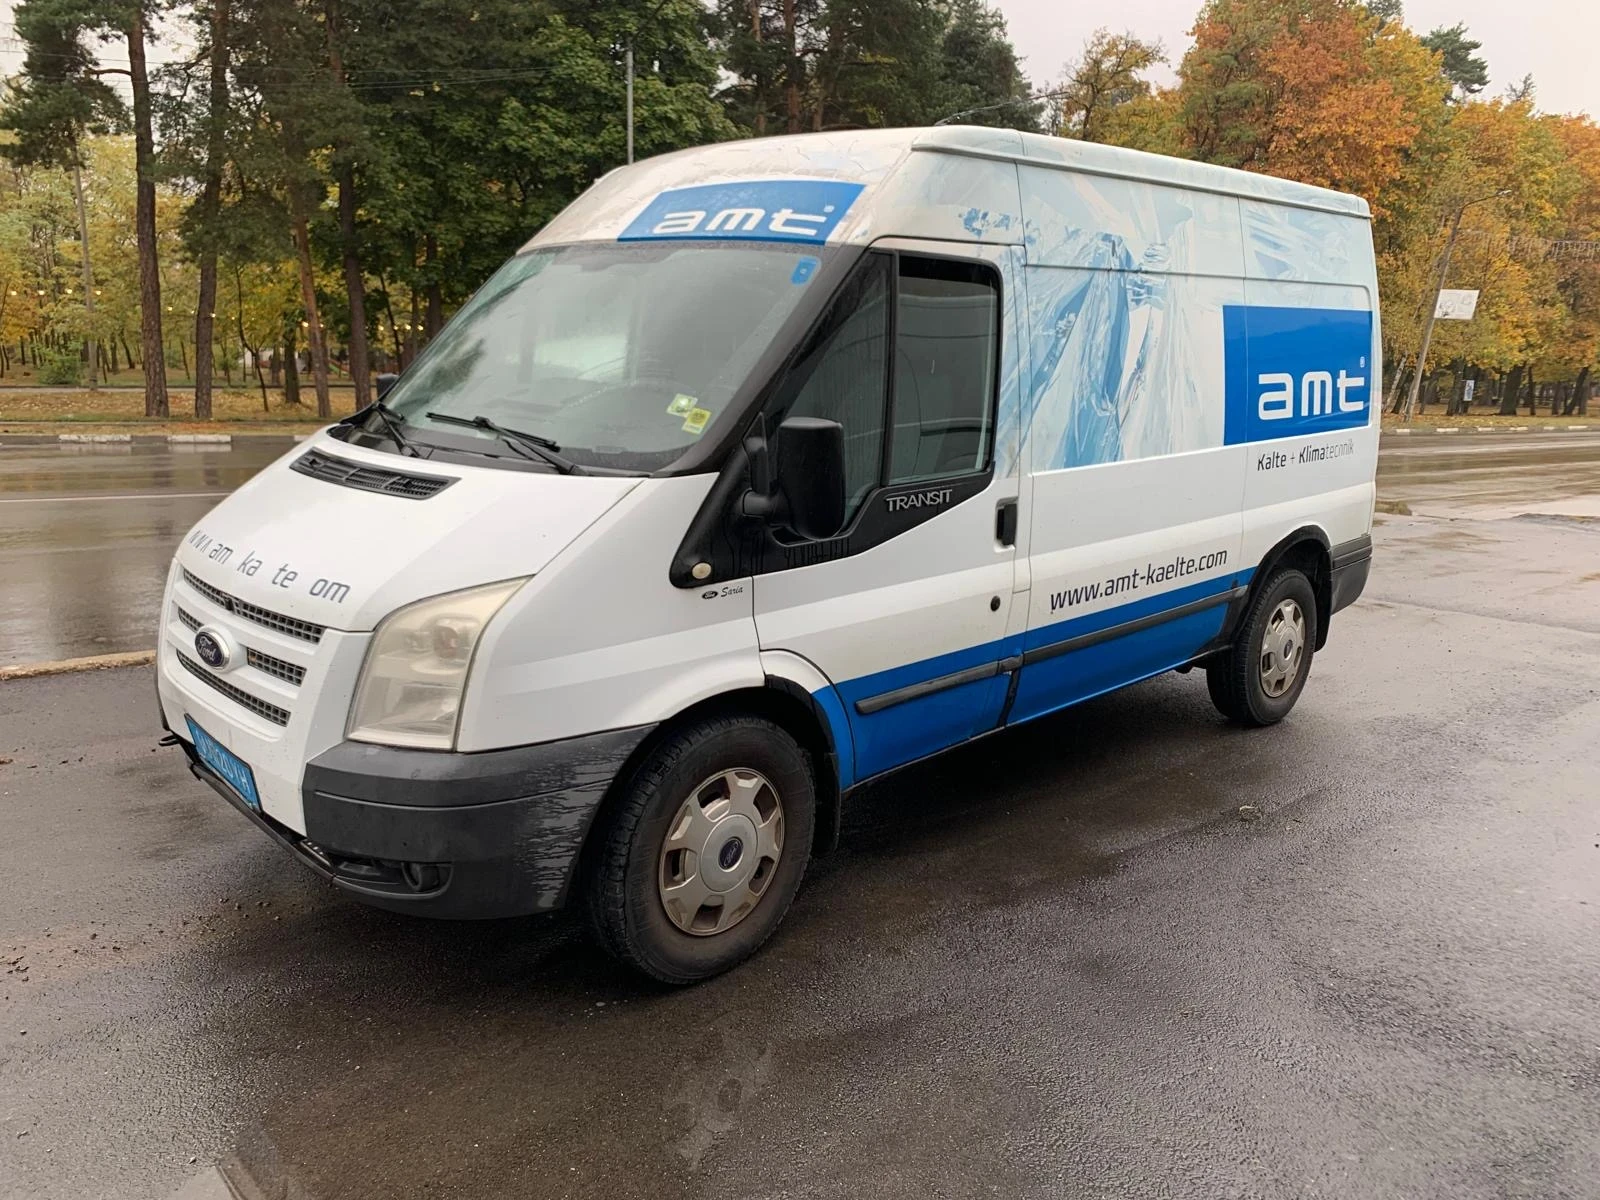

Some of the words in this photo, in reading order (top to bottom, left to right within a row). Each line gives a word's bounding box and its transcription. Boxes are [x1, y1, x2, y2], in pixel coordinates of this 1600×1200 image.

[652, 208, 827, 236] amt
[1258, 370, 1364, 420] amt
[886, 489, 953, 512] TRANSIT
[208, 543, 234, 565] am
[236, 550, 263, 577] ka
[271, 563, 299, 588] te
[309, 578, 351, 603] om
[1050, 550, 1228, 611] www.amt-kaelte.com
